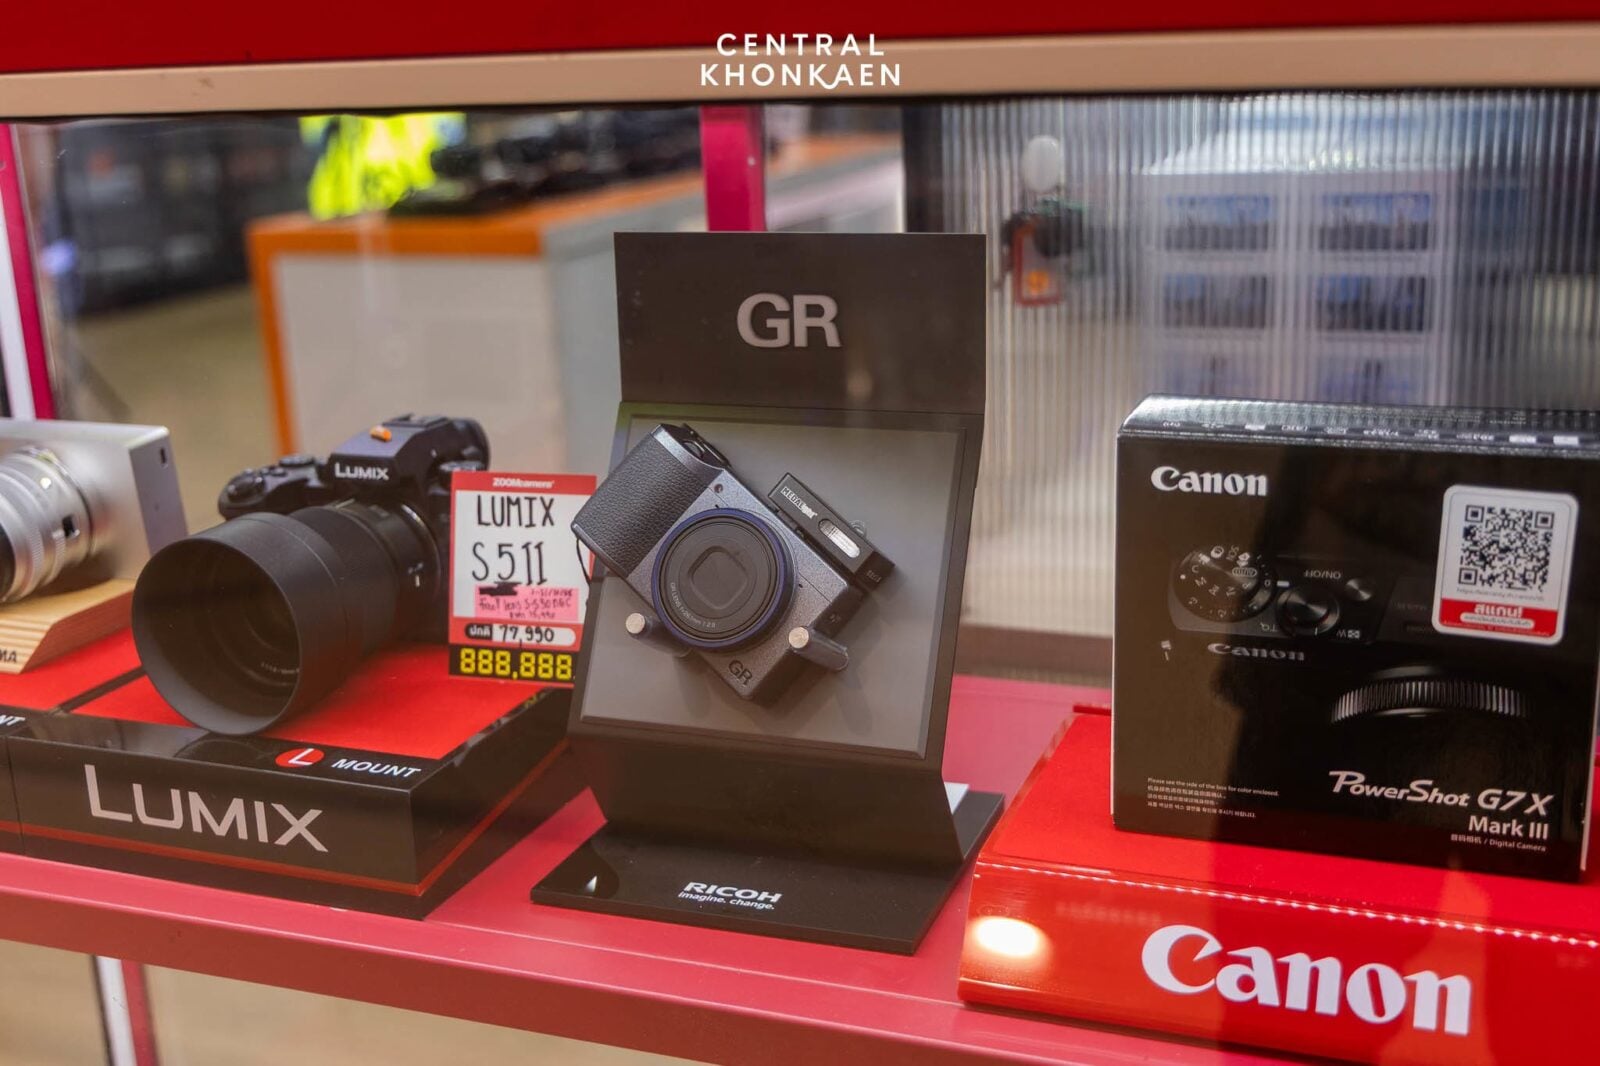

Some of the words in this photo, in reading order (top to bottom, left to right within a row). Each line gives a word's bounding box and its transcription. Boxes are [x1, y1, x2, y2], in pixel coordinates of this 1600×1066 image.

[737, 292, 841, 348] GR
[334, 462, 389, 482] LUMIX
[1150, 465, 1267, 497] Canon
[477, 495, 555, 529] LUMIX
[499, 624, 555, 649] 77,990
[1207, 643, 1305, 661] Canon
[728, 659, 753, 686] GR
[288, 748, 315, 766] L
[332, 758, 422, 778] MOUNT
[1328, 770, 1470, 807] PowerShot
[84, 763, 329, 853] LUMIX
[1468, 814, 1523, 837] Mark
[1528, 822, 1549, 840] III
[1489, 838, 1515, 849] Digital
[1516, 841, 1547, 852] Camera
[678, 891, 727, 904] imagine.
[729, 899, 775, 910] change.
[683, 881, 782, 903] RICOH
[1141, 924, 1472, 1036] Canon
